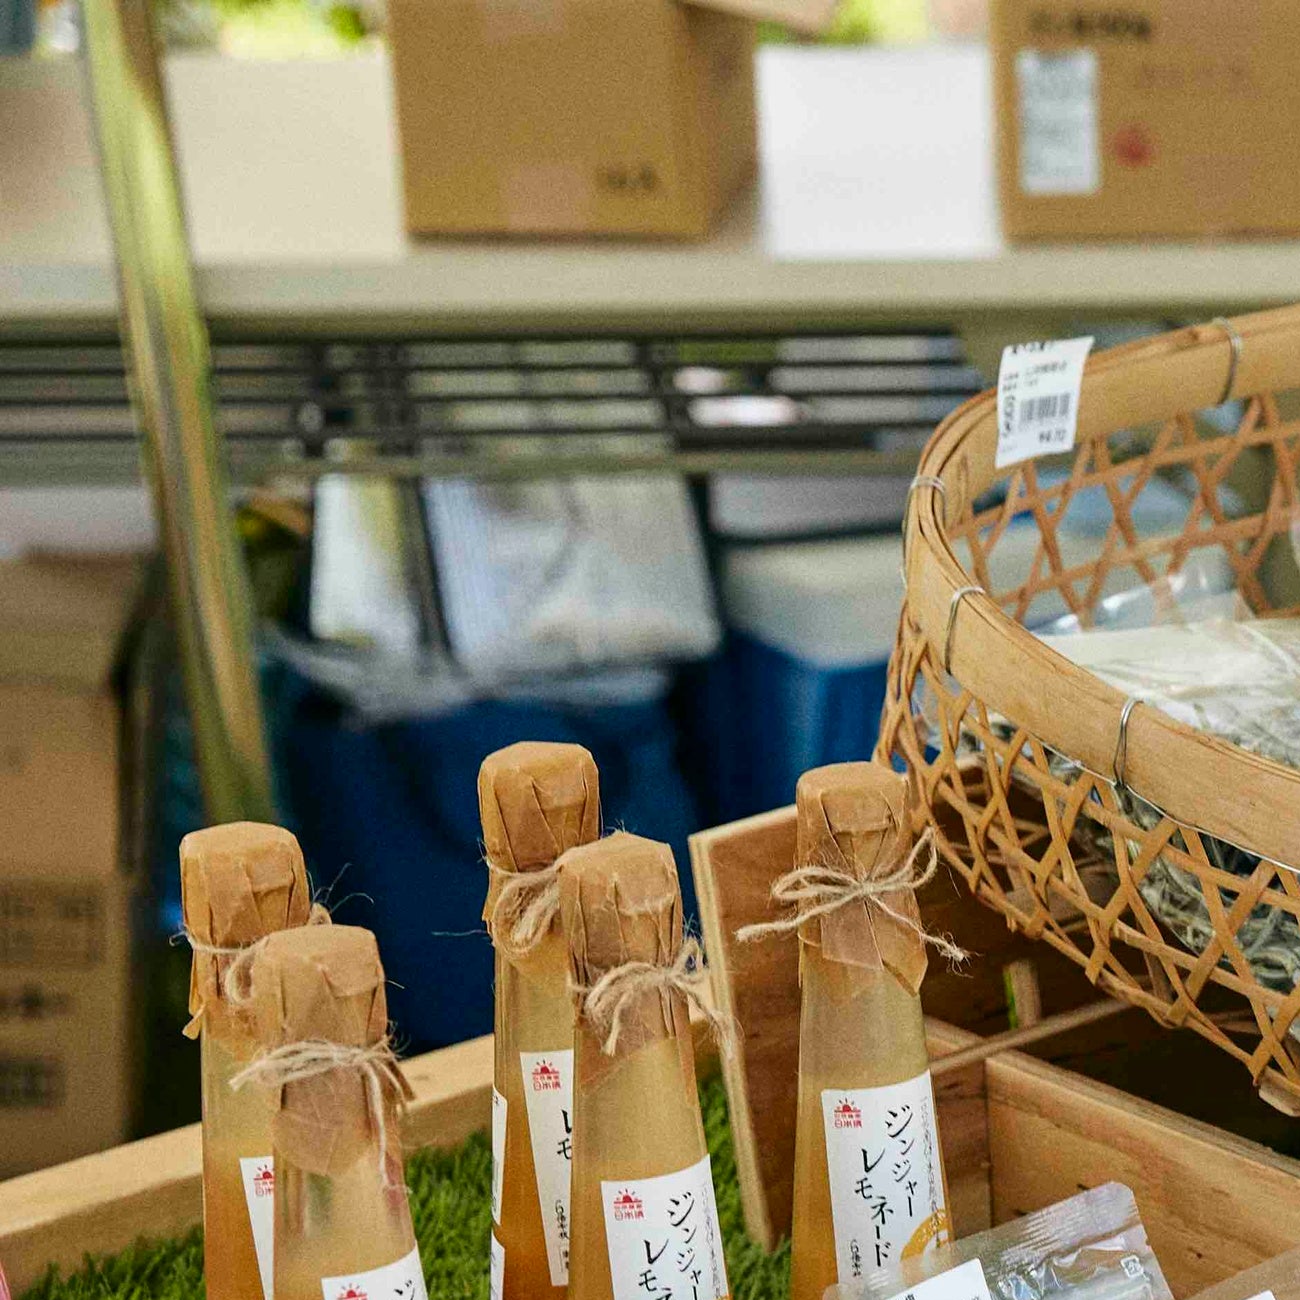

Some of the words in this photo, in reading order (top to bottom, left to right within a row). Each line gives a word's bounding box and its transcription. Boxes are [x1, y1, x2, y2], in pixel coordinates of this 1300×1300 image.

[854, 1148, 894, 1268] レモネード
[885, 1104, 918, 1218] ジンジャー
